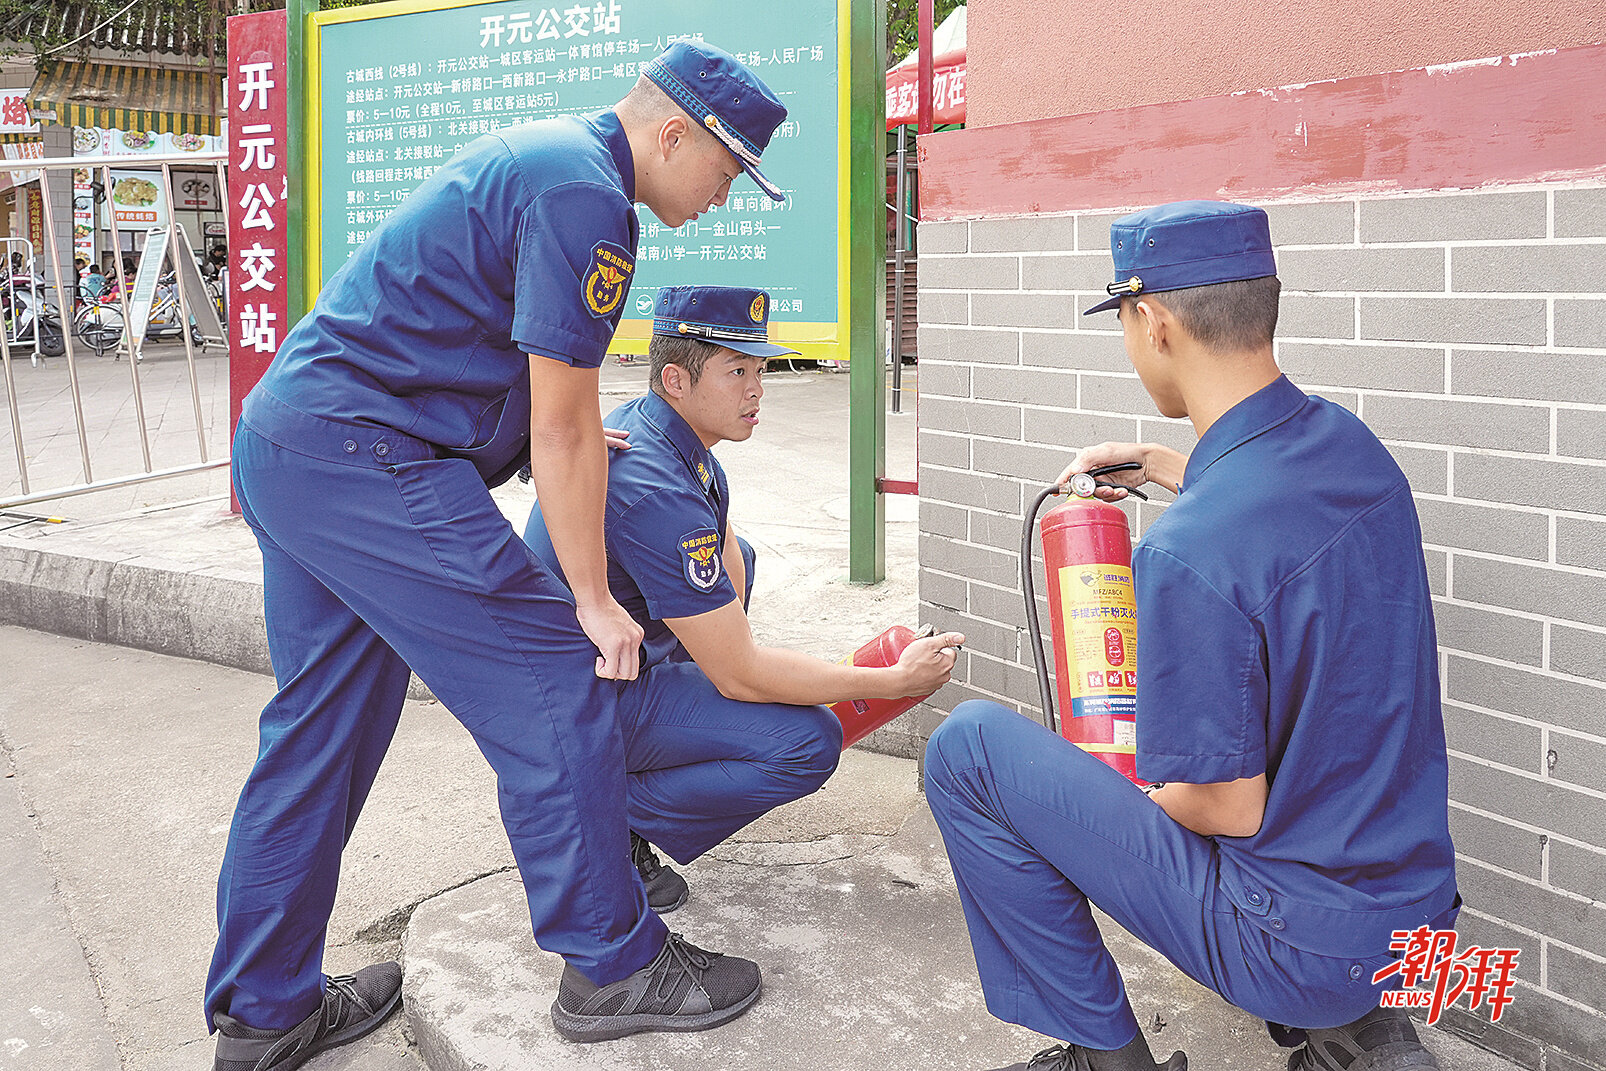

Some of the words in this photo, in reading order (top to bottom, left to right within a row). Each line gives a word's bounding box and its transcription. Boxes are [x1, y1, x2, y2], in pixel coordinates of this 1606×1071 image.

[479, 1, 622, 49] 开元公交站
[237, 61, 278, 354] 开元公交站
[1070, 605, 1137, 620] 手提式干粉灭火
